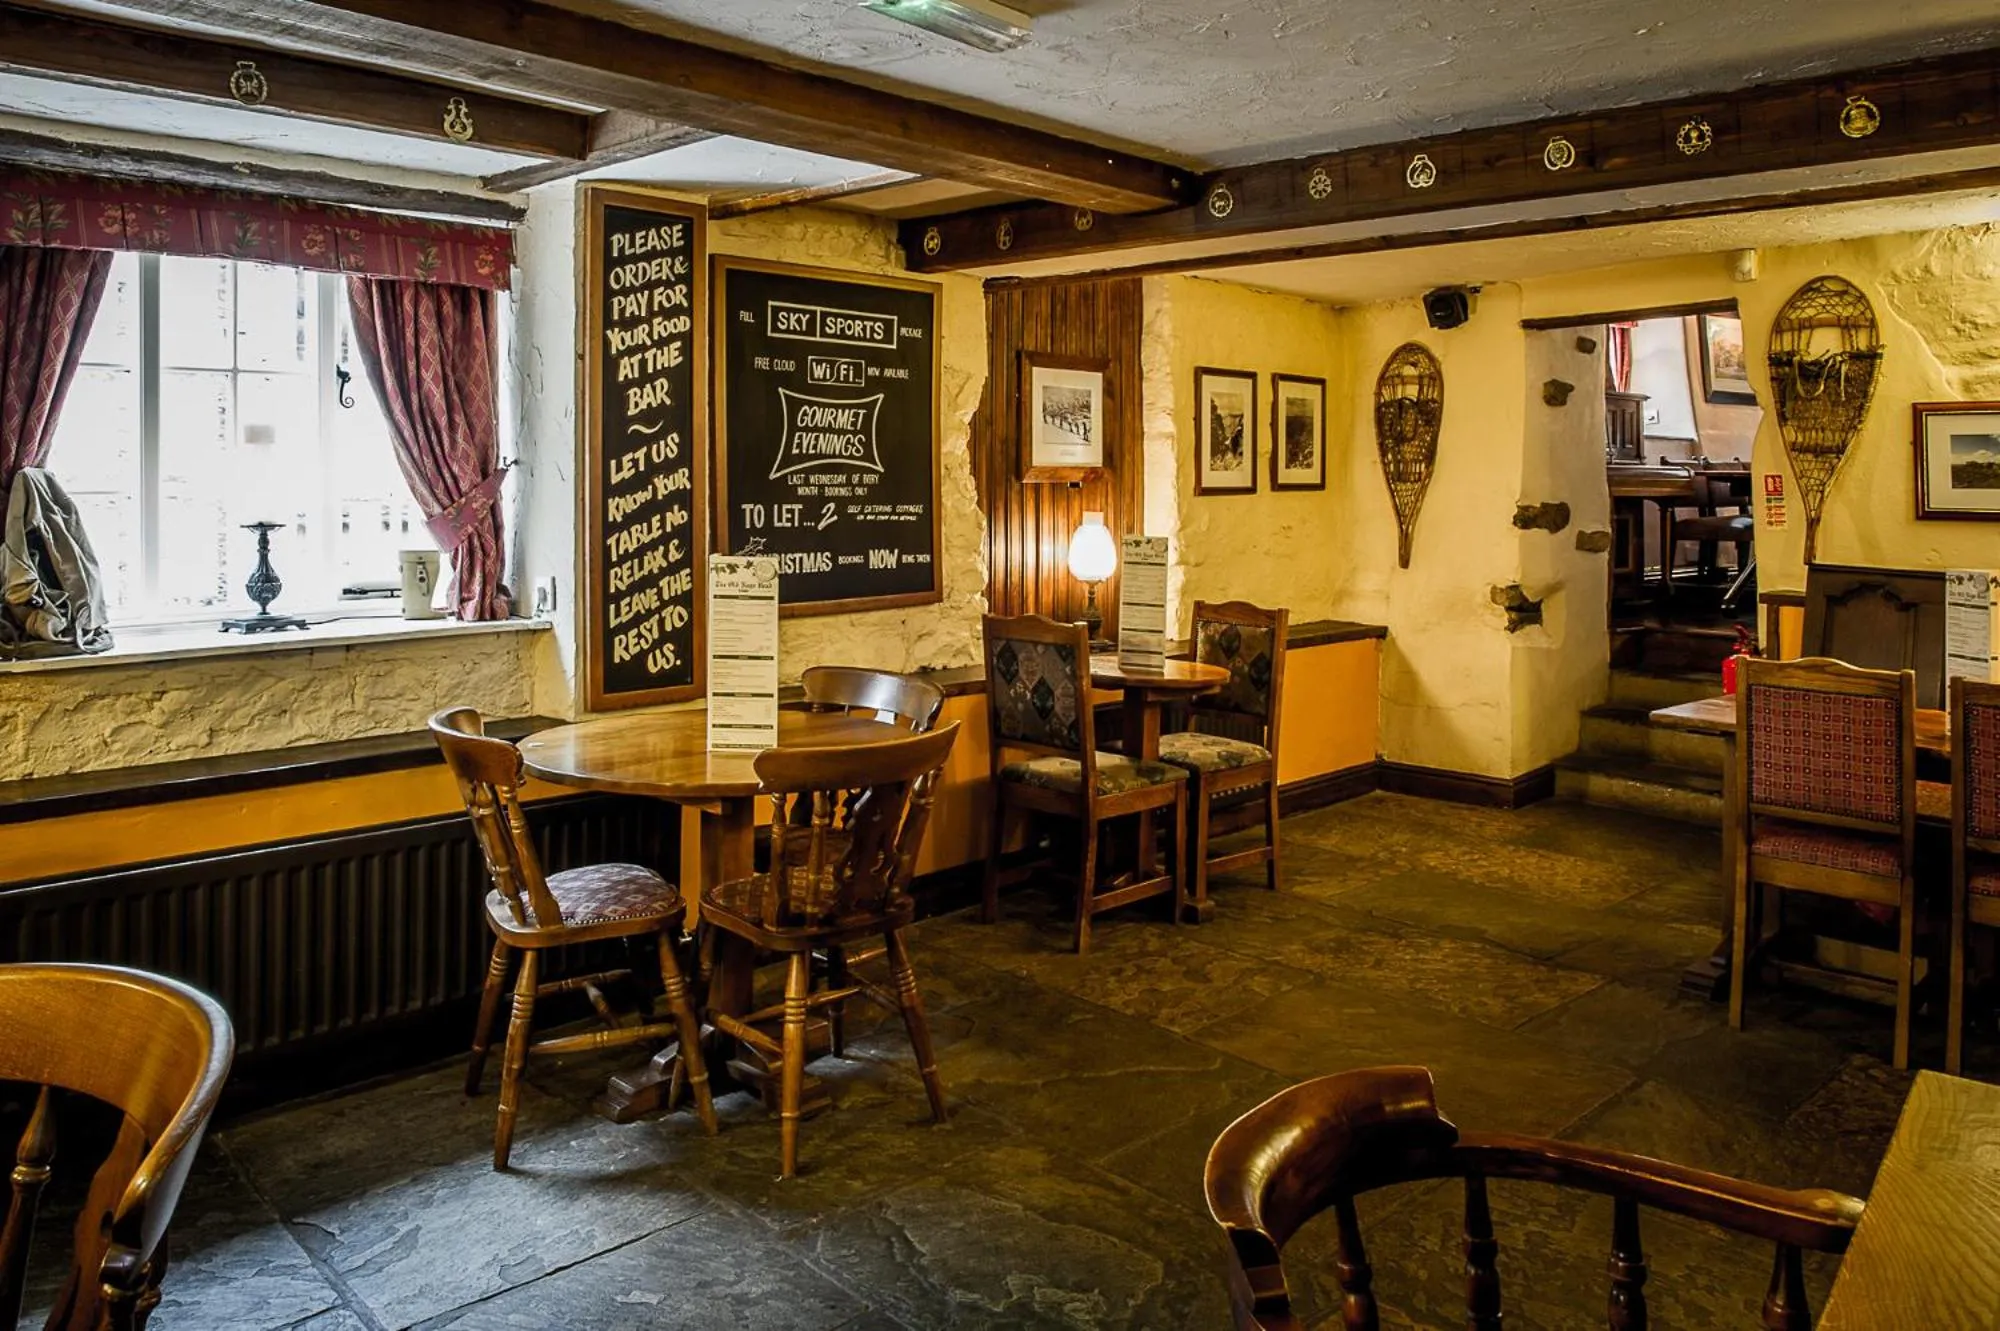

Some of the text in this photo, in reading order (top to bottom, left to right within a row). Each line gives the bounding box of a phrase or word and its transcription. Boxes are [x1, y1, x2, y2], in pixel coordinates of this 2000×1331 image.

[610, 224, 684, 256] PLEASE
[609, 284, 688, 320] PAY FOR
[606, 316, 691, 354] YOUR FOOD
[739, 310, 755, 323] FULL
[777, 312, 810, 331] SKY
[825, 317, 885, 340] SPORTS
[618, 341, 683, 382] AT THE
[755, 357, 770, 370] FREE
[773, 359, 795, 372] CLOUD
[627, 377, 671, 416] BAR
[797, 405, 868, 430] GOURMET
[610, 432, 679, 485] LET US
[792, 432, 866, 456] EVENINGS
[654, 468, 691, 499] YOUR
[788, 474, 804, 485] LAST
[809, 474, 846, 485] WEDNESDAY
[852, 474, 862, 485] OF
[825, 486, 852, 497] BOOKINGS
[741, 503, 765, 529] TO
[817, 502, 838, 531] 2
[607, 514, 662, 561] TABLE
[610, 539, 685, 593] RELAX &
[838, 555, 864, 565] BOOKINGS
[868, 548, 899, 569] NOW
[610, 568, 692, 628] LEAVE THE
[614, 614, 659, 663] REST
[661, 605, 688, 631] TO
[647, 643, 681, 673] US.
